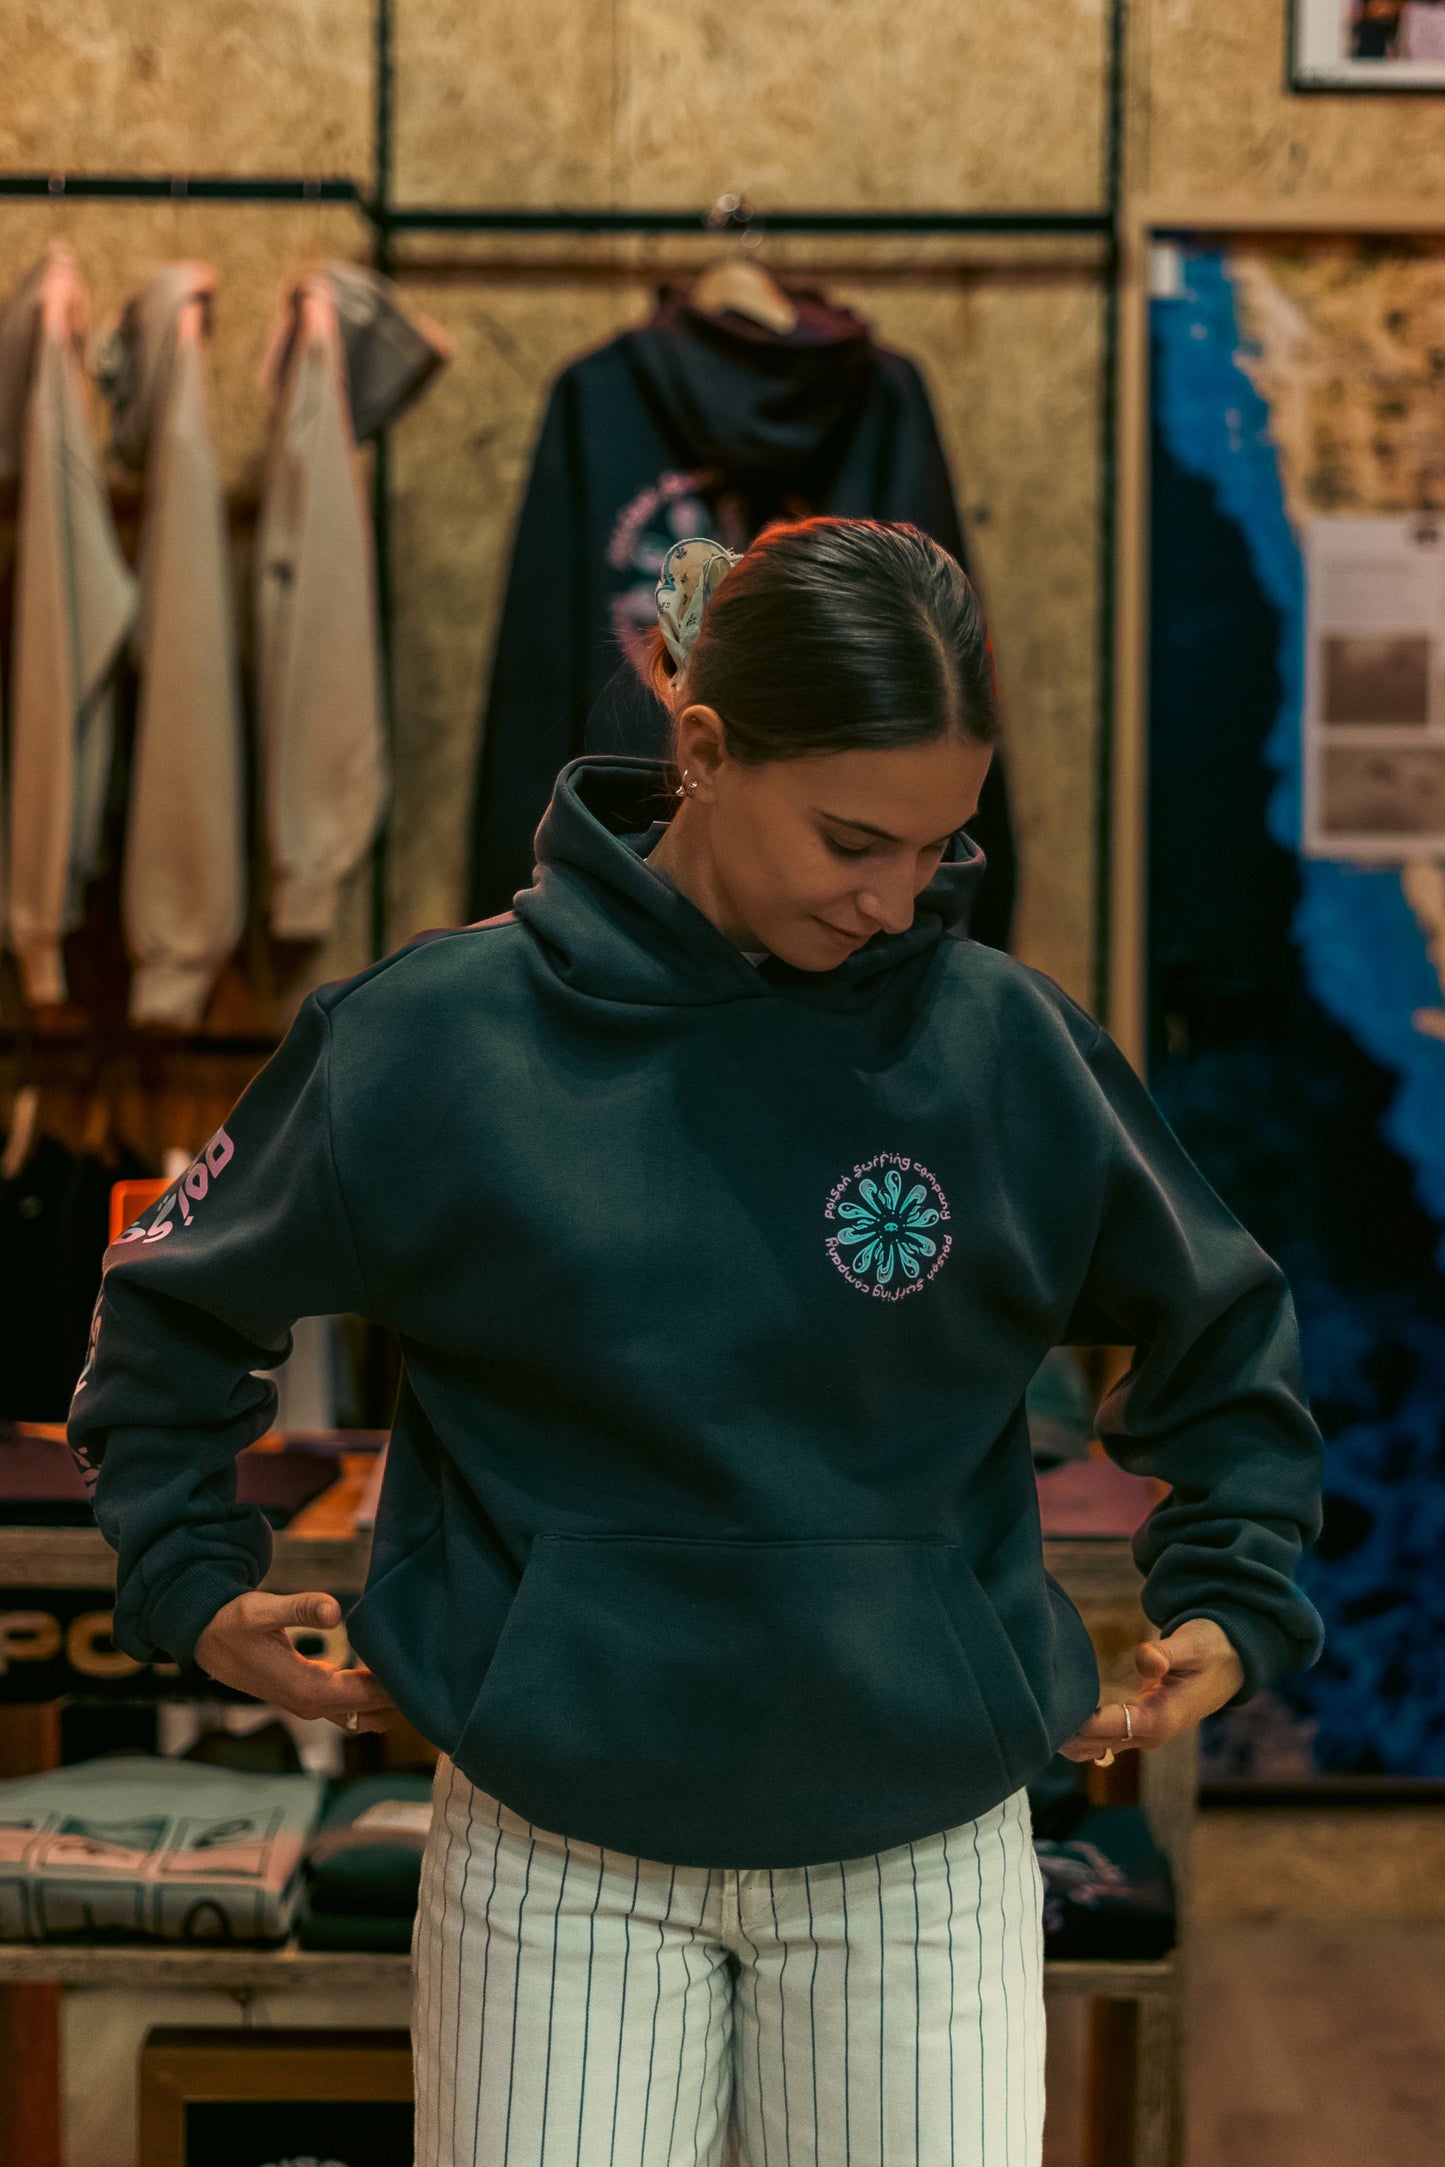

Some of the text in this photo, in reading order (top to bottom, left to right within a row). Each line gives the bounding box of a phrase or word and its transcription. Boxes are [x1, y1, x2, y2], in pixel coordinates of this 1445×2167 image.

[110, 1126, 235, 1245] poiso
[824, 1151, 951, 1220] poison surfing company
[825, 1234, 953, 1302] poison surfing company
